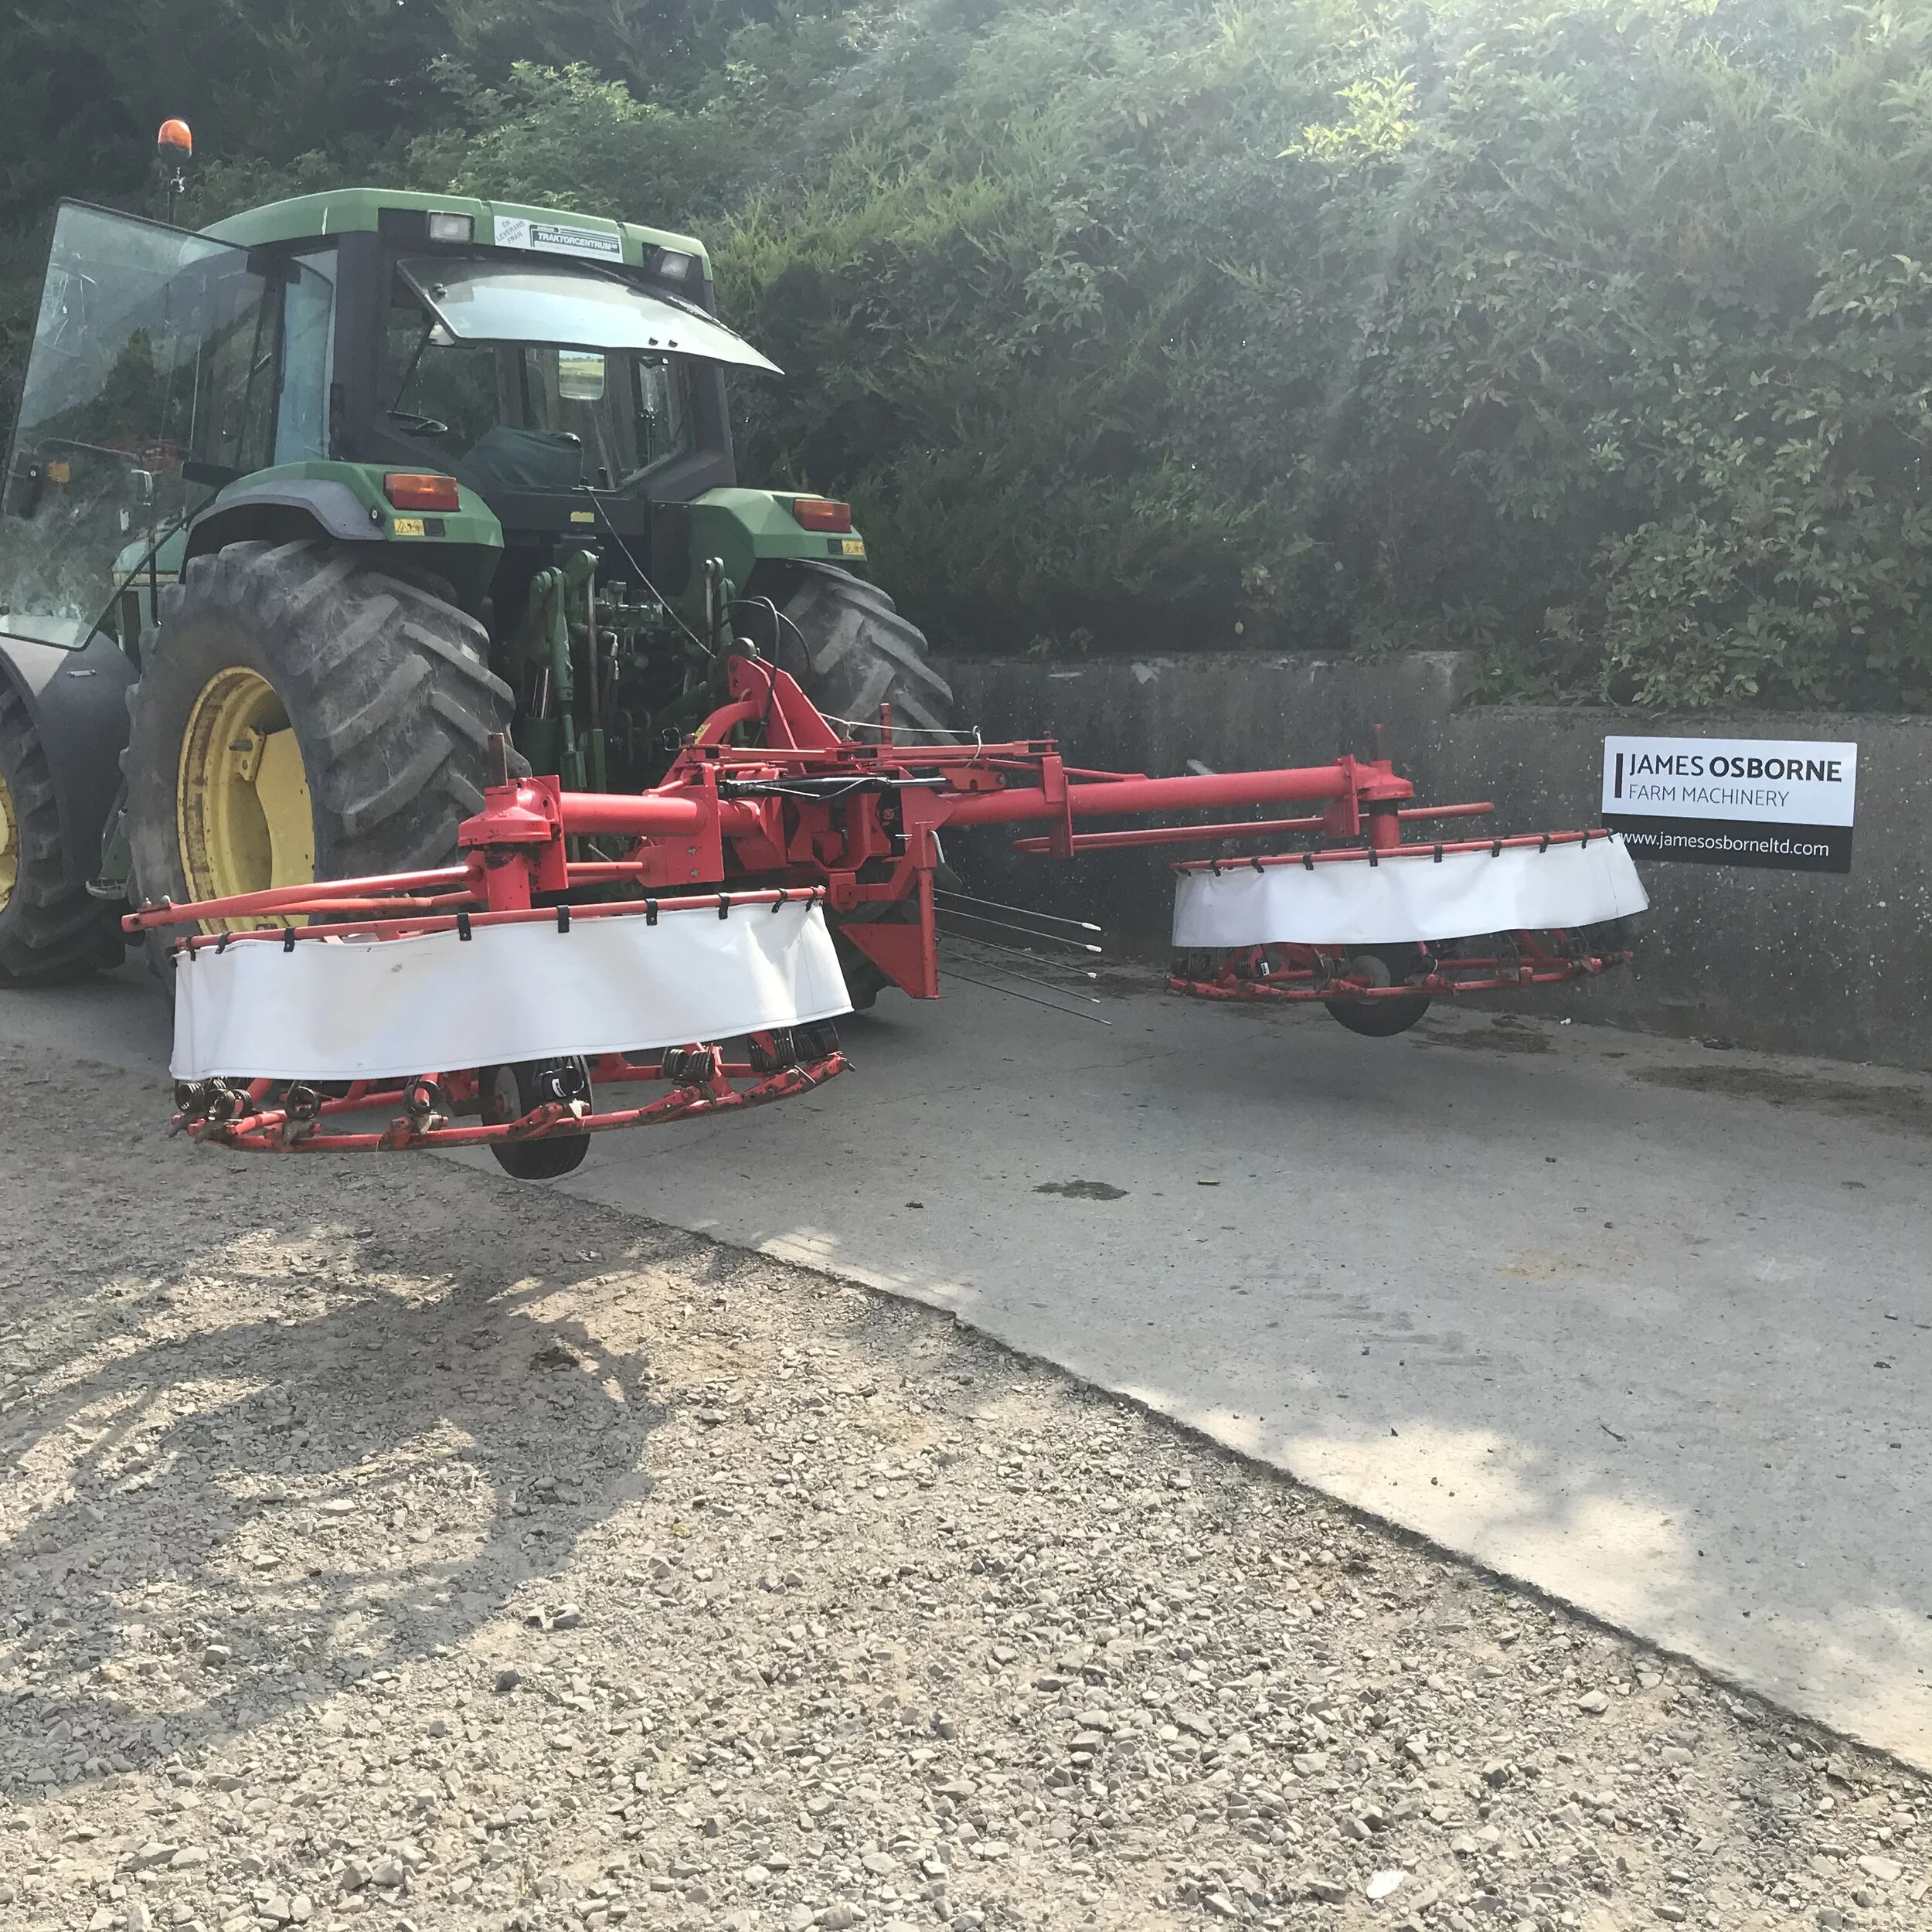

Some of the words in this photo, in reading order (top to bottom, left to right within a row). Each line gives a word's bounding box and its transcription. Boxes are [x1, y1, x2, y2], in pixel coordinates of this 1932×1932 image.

[496, 220, 525, 242] LEVERANS
[502, 219, 511, 228] EN
[538, 233, 611, 250] TRAKTORCENTRUM
[1629, 754, 1703, 777] JAMES
[1709, 757, 1842, 782] OSBORNE
[1629, 784, 1675, 801] FARM
[1682, 787, 1790, 807] MACHINERY
[1620, 831, 1829, 855] www.jamesosborneltd.com
